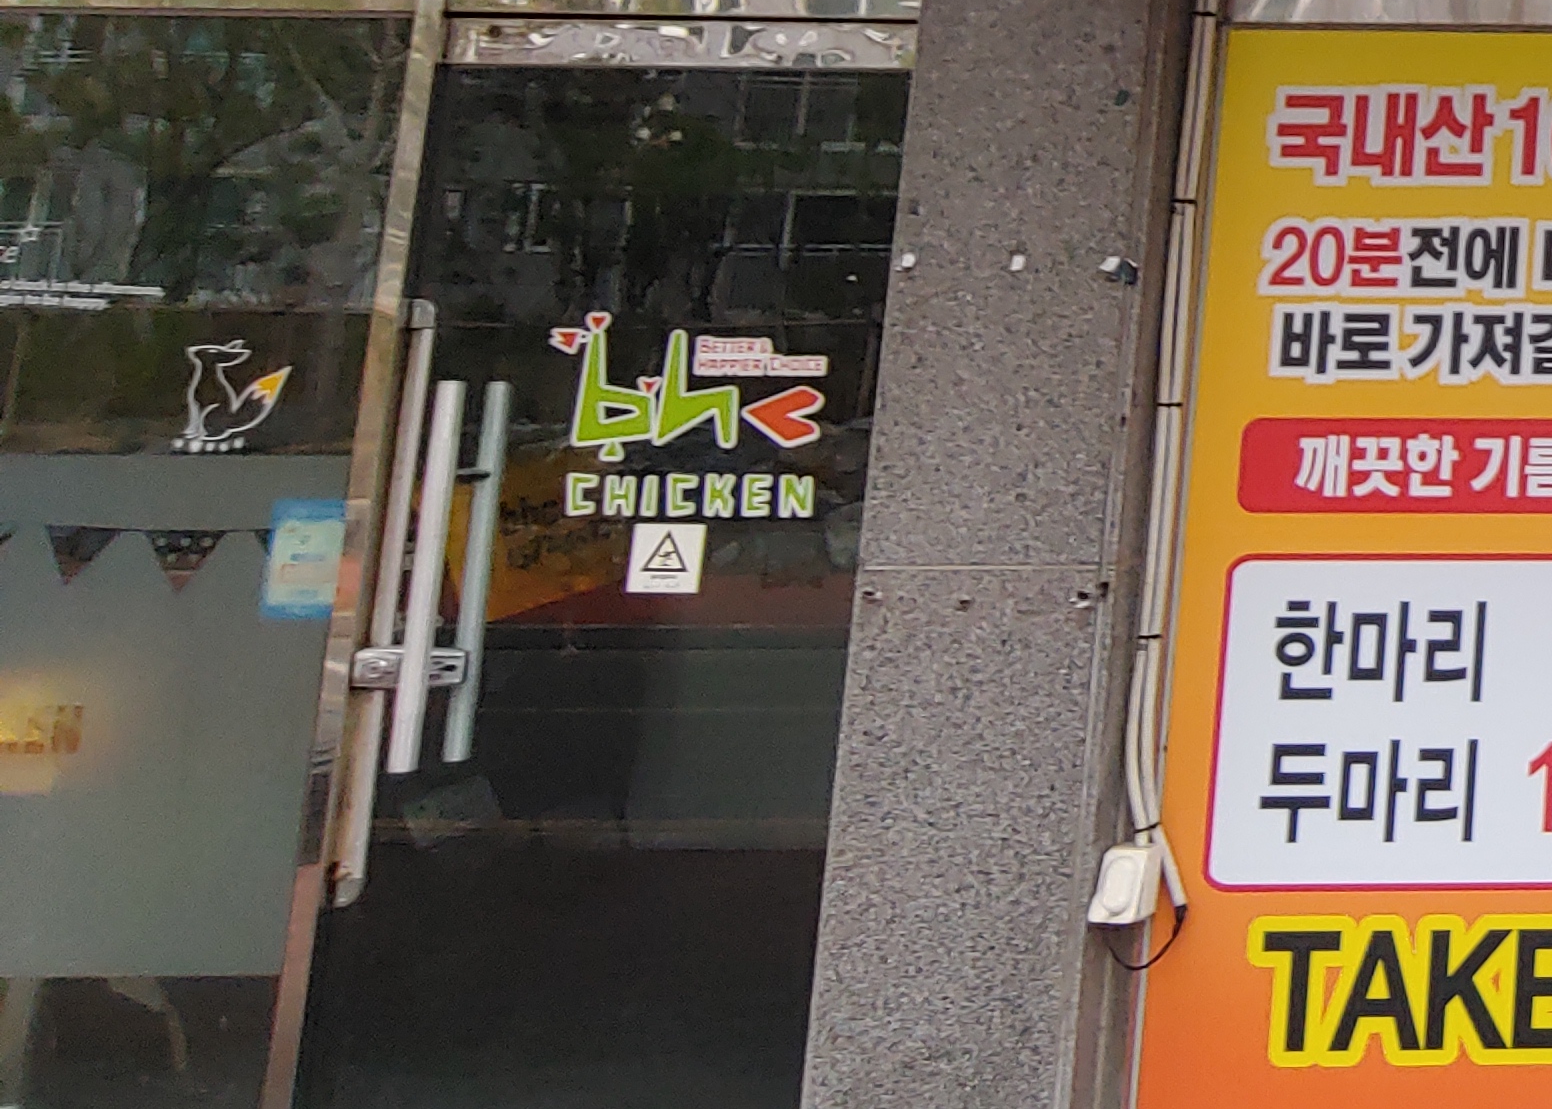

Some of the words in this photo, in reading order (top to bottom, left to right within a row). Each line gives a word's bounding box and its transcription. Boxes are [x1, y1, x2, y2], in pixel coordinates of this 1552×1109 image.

[1276, 92, 1490, 180] 국내산
[1268, 224, 1519, 290] 20분전에
[1279, 310, 1391, 375] 바로
[560, 312, 825, 461] bhc
[566, 473, 815, 518] CHICKEN
[1297, 435, 1457, 498] 깨끗한
[1273, 600, 1488, 702] 한마리
[1259, 739, 1479, 844] 두마리
